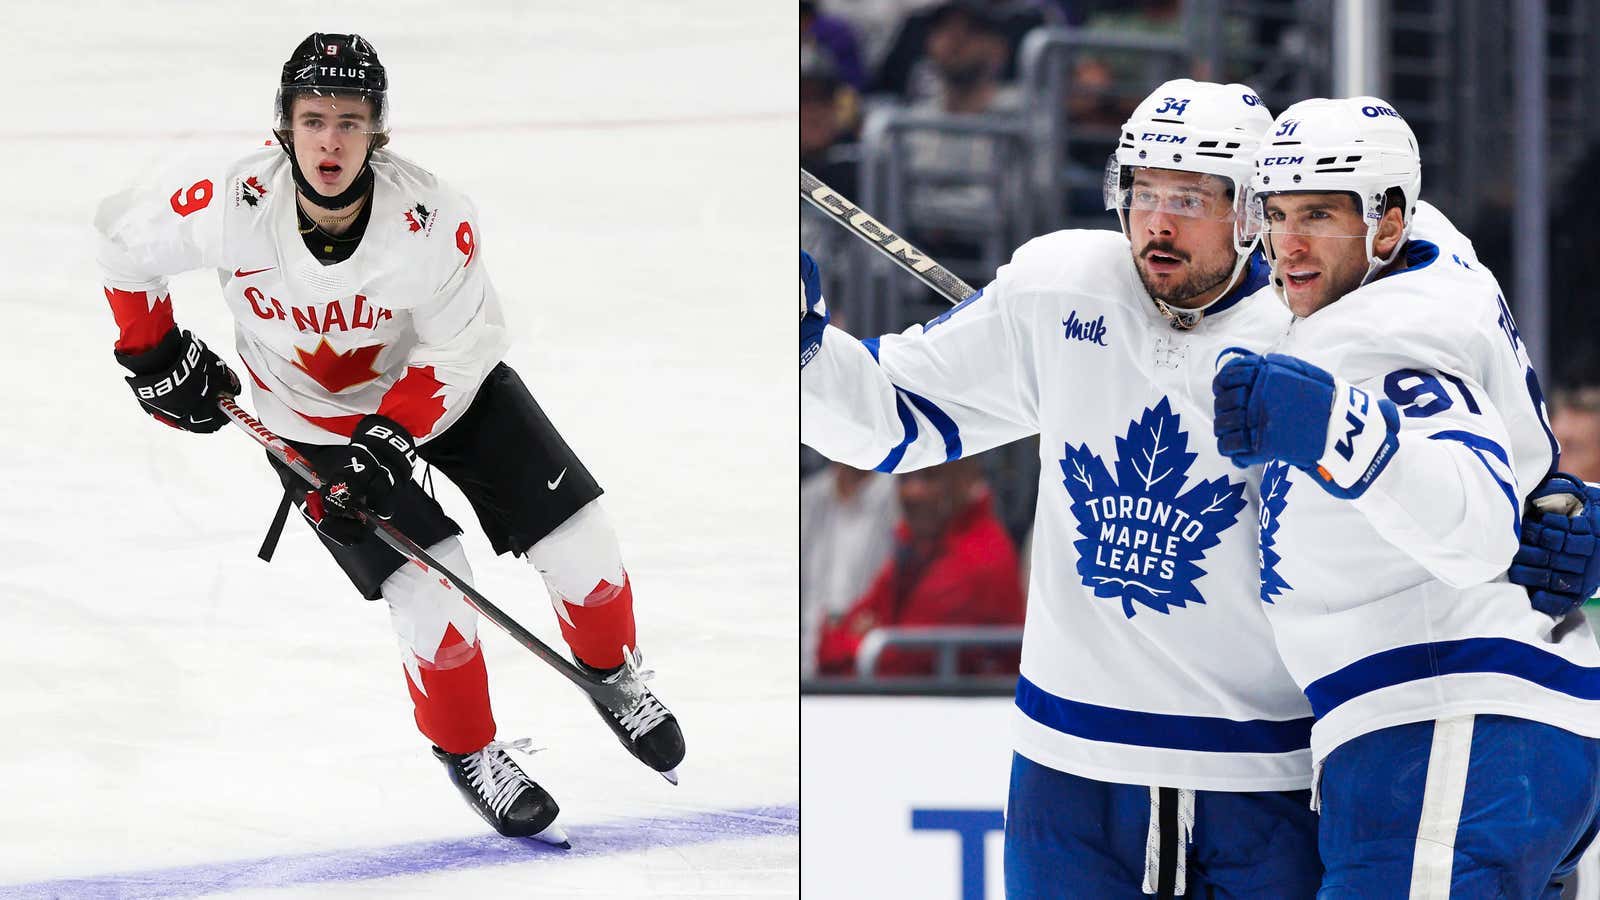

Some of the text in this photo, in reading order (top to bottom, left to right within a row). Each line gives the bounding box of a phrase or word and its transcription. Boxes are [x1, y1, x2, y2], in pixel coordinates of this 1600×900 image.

[326, 44, 338, 56] 9
[319, 66, 366, 79] TELUS
[1156, 97, 1191, 116] 34
[1141, 132, 1188, 144] CCM
[1264, 156, 1304, 167] CCM
[170, 178, 214, 218] 9
[455, 221, 475, 268] 9
[811, 186, 936, 273] CCM
[1062, 310, 1109, 348] Milk
[1383, 368, 1482, 418] 91
[1085, 495, 1203, 544] TORONTO
[1099, 522, 1180, 557] MAPLE
[1095, 545, 1176, 581] LEAFS
